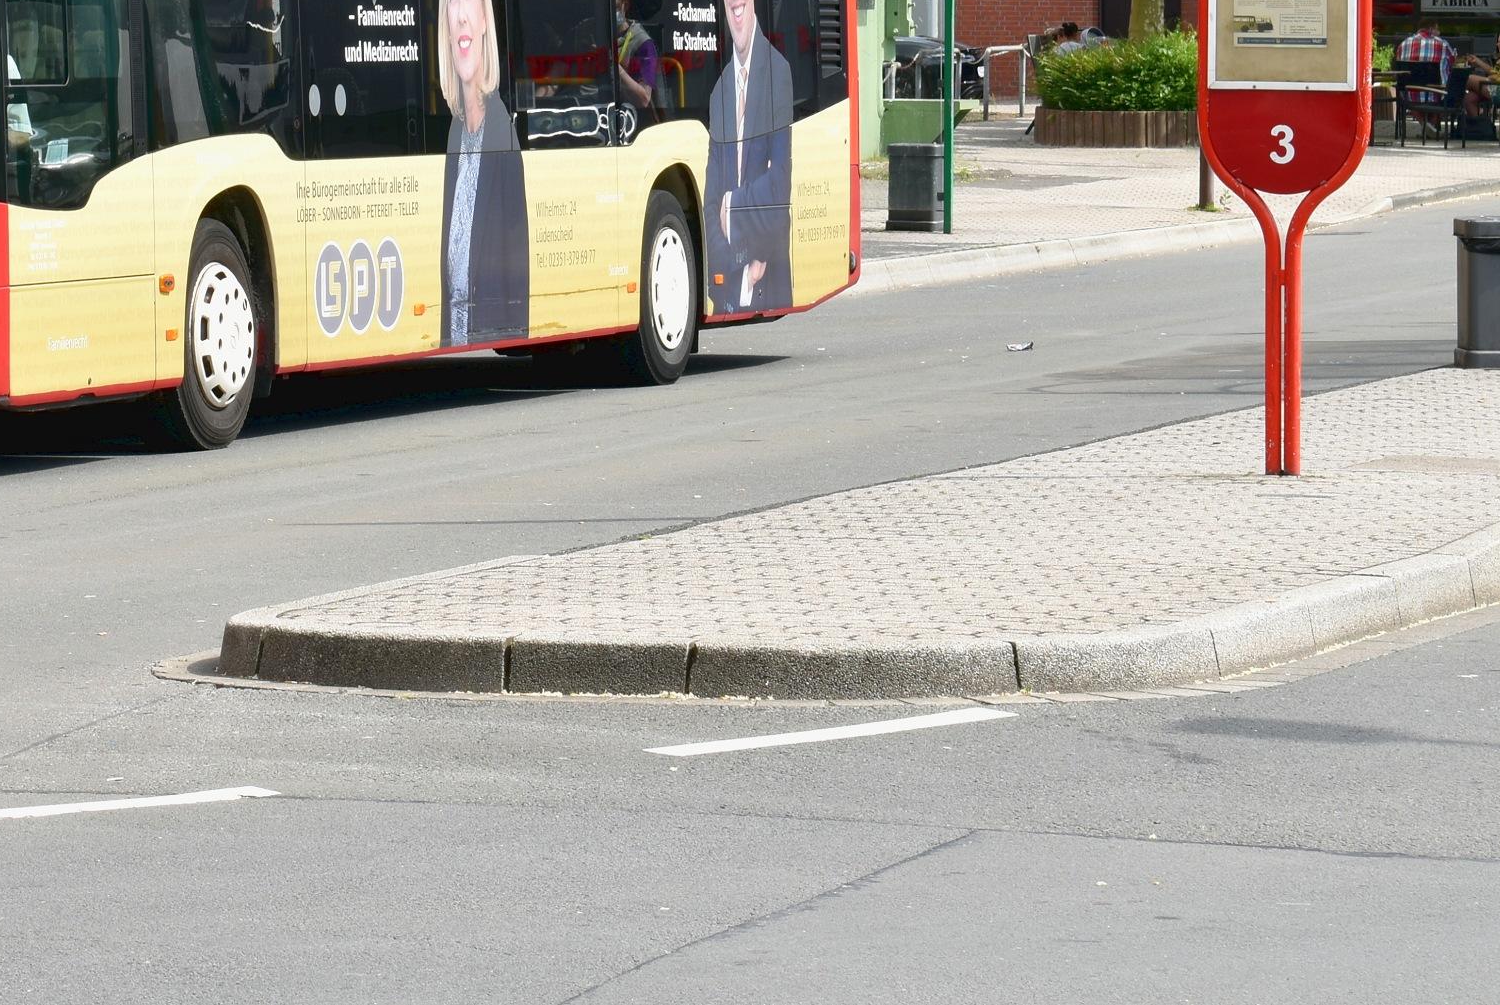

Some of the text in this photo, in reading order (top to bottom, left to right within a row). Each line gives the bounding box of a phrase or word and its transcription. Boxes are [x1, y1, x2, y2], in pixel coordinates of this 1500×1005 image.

[357, 4, 415, 27] Familienrecht
[345, 39, 418, 63] und Medizinrecht
[673, 30, 717, 52] für Strafrecht
[1268, 124, 1296, 165] 3
[295, 174, 419, 202] Ihre Bürogemeinschaft für alle Fälle
[296, 205, 317, 224] LÖBER
[322, 204, 360, 222] SONNEBORN
[367, 202, 393, 219] PETEREIT
[398, 201, 419, 217] TELLER
[569, 200, 577, 216] 24
[535, 225, 573, 244] Lüdenscheid
